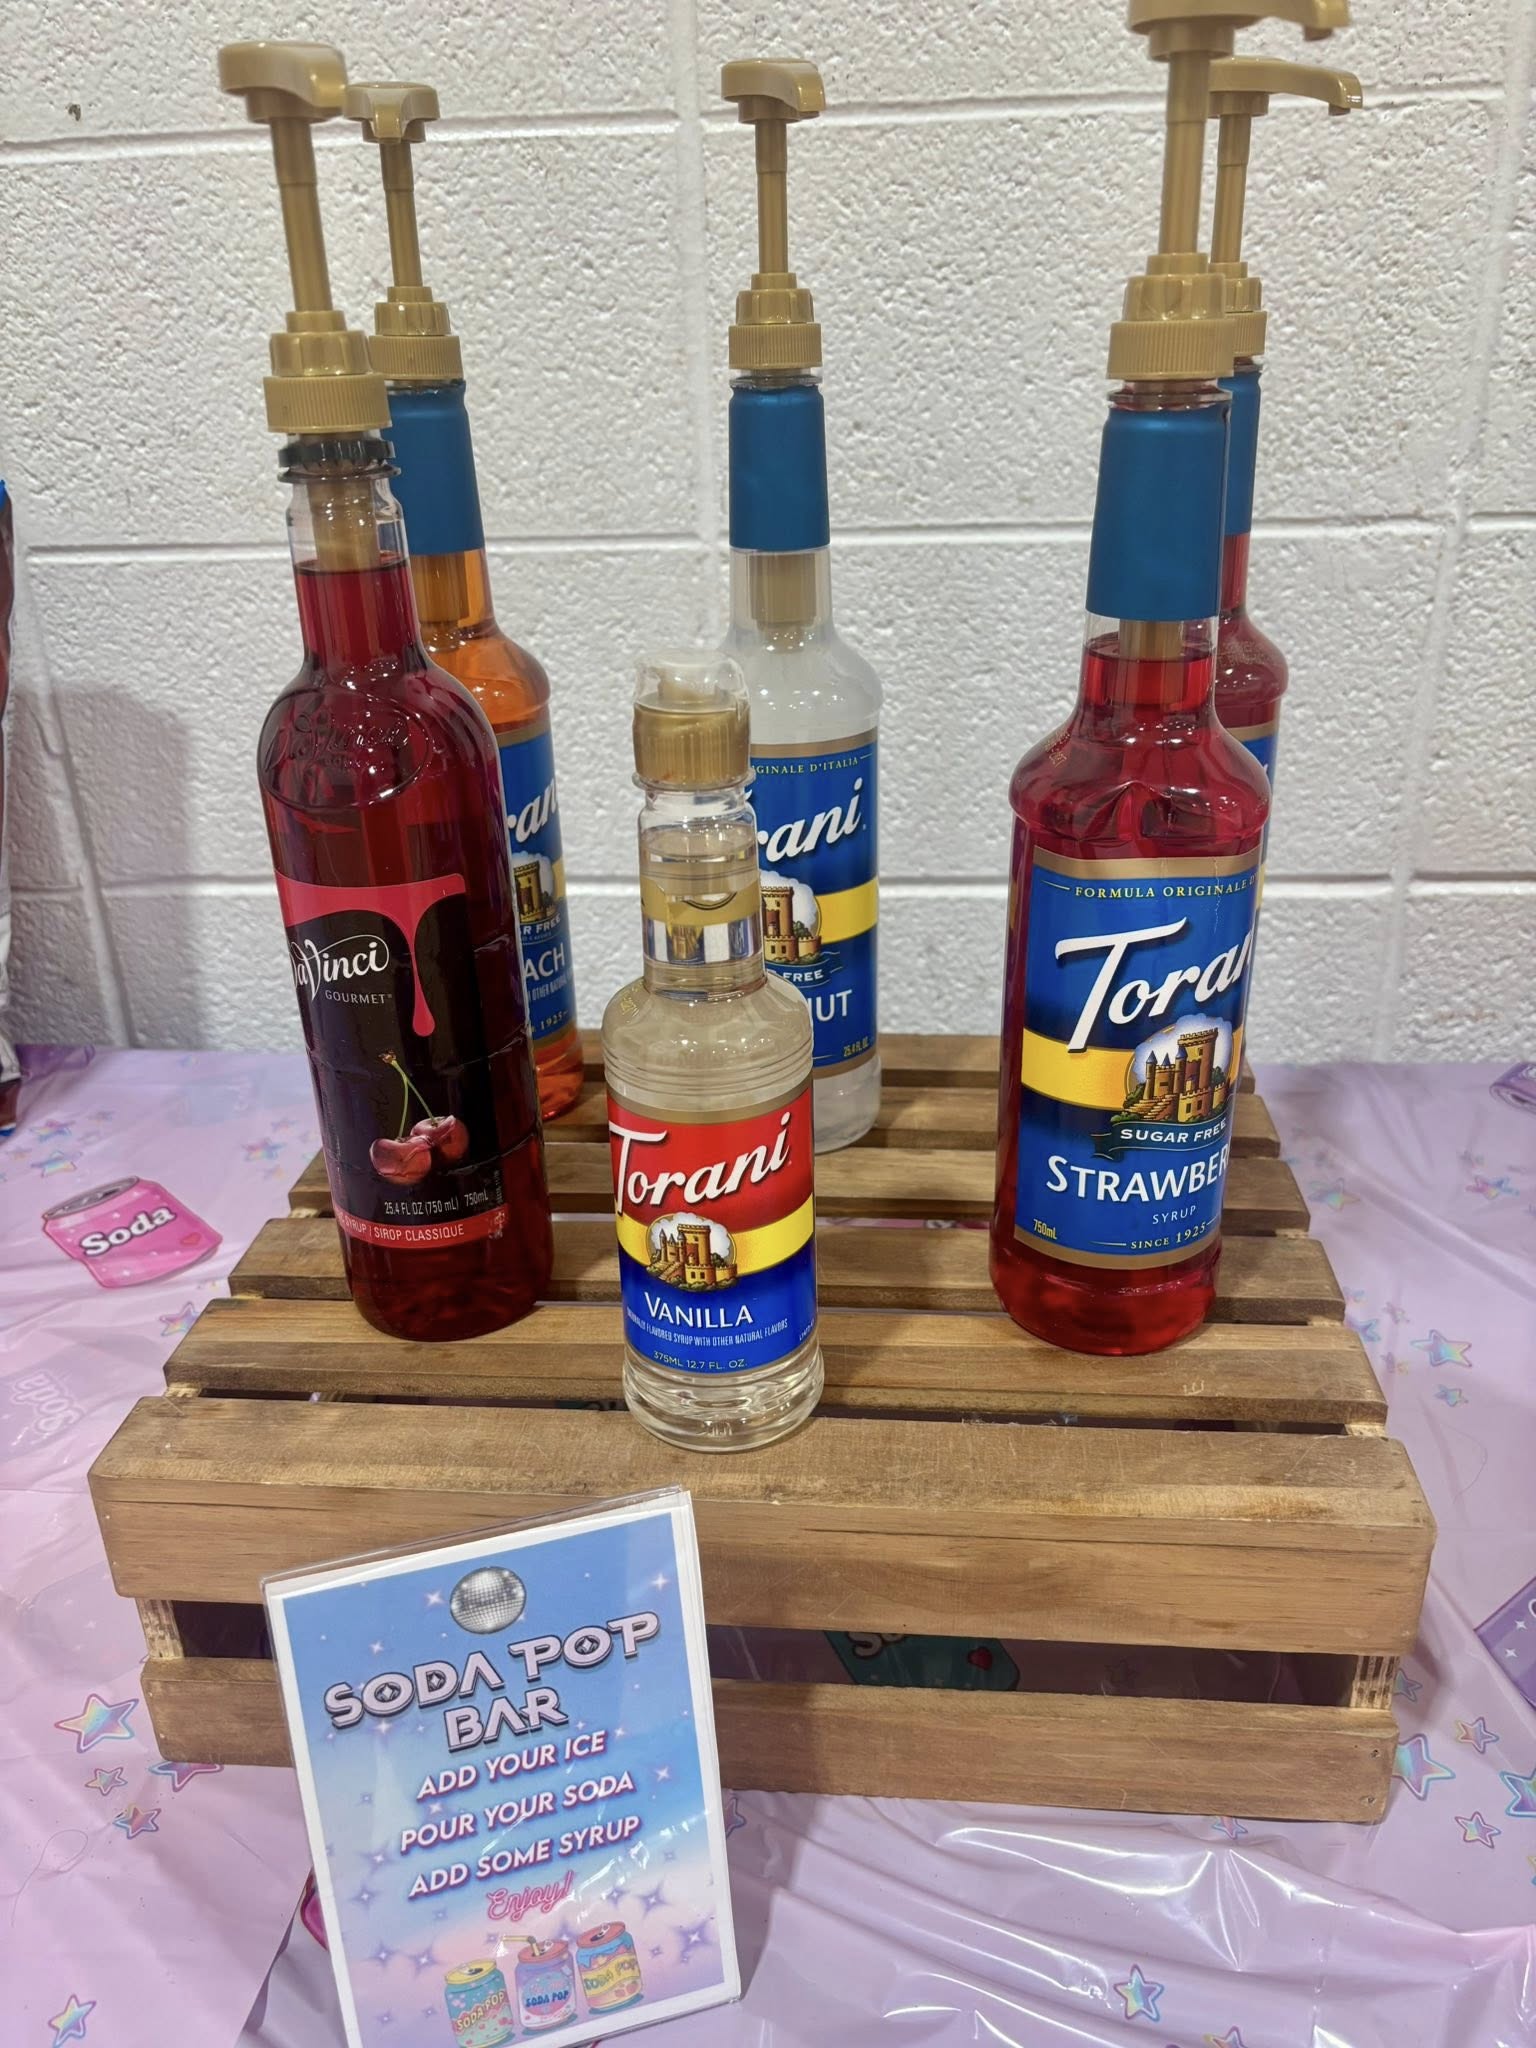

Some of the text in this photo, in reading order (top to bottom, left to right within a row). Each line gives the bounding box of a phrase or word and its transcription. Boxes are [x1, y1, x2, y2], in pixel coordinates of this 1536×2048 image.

[810, 757, 858, 772] D'ITALIA
[1075, 880, 1247, 898] FORMULA ORIGINALE
[782, 969, 824, 982] FREE
[325, 989, 386, 1004] GOURMET
[1120, 1117, 1226, 1143] SUGAR FREE
[608, 1111, 790, 1216] Torani
[384, 1201, 400, 1215] 25.4
[401, 1201, 411, 1215] FL
[412, 1201, 424, 1215] OZ
[425, 1200, 442, 1216] (750
[1152, 1205, 1197, 1225] SYRUP
[80, 1205, 177, 1256] Soda
[374, 1227, 402, 1241] SIROP
[405, 1223, 465, 1241] CLASSIQUE
[1033, 1218, 1058, 1240] 750mL
[1130, 1221, 1206, 1249] SINCE 1925
[644, 1291, 753, 1328] VANILLA
[673, 1332, 693, 1345] SYRUP
[693, 1336, 711, 1346] WITH
[712, 1336, 734, 1346] OTHER
[735, 1329, 763, 1344] NATURAL
[764, 1318, 788, 1336] FLAVORS
[653, 1350, 684, 1367] 375ML
[686, 1360, 706, 1369] 12.7
[324, 1611, 660, 1729] SODA POP
[443, 1686, 569, 1753] BAR
[416, 1730, 607, 1801] ADD YOUR ICE
[400, 1770, 636, 1854] POUR YOUR SODA
[408, 1815, 641, 1900] ADD SOME SYRUP
[486, 1870, 576, 1922] Enjoy!
[455, 1991, 506, 2031] SODA POP
[525, 1989, 570, 2008] SODA POP
